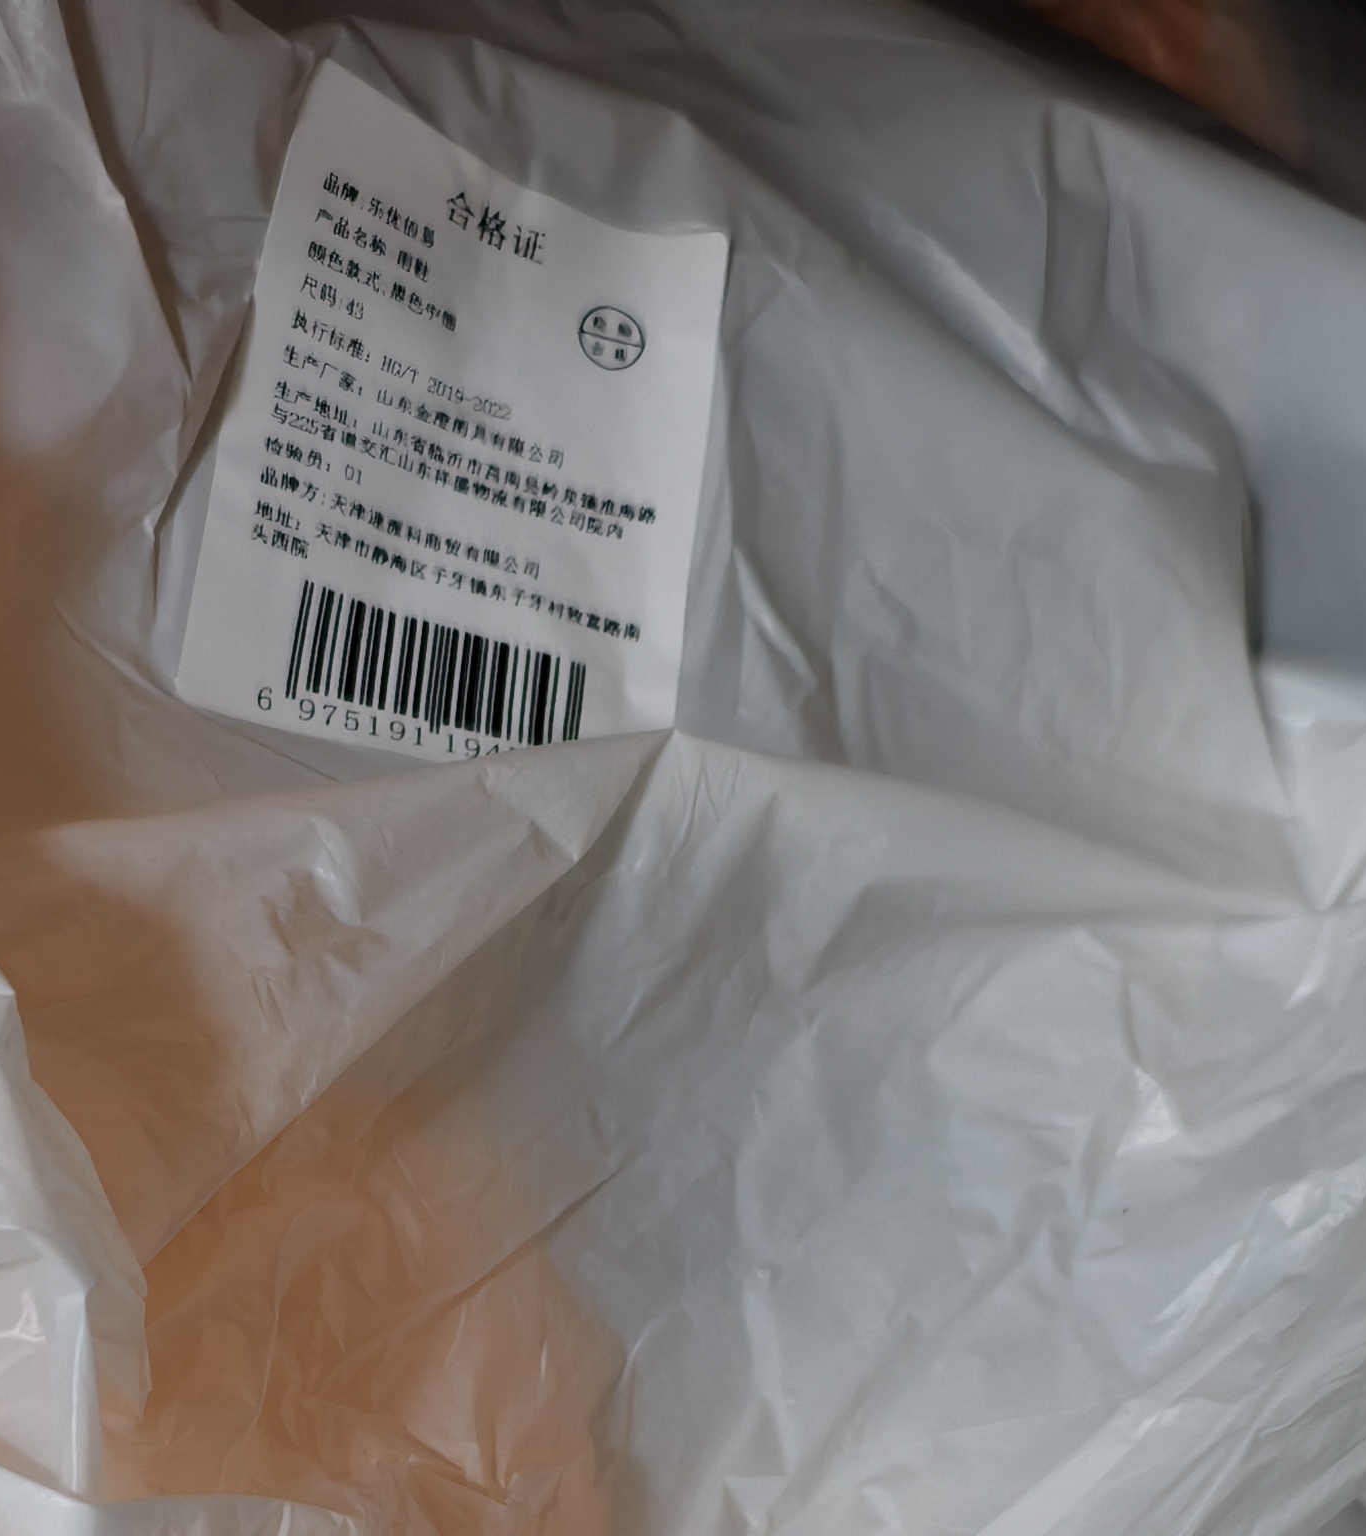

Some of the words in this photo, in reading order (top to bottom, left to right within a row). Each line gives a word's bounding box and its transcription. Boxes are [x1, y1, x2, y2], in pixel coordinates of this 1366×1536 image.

[445, 192, 547, 265] 合格证
[257, 687, 273, 712] 6
[298, 699, 425, 747] 975191
